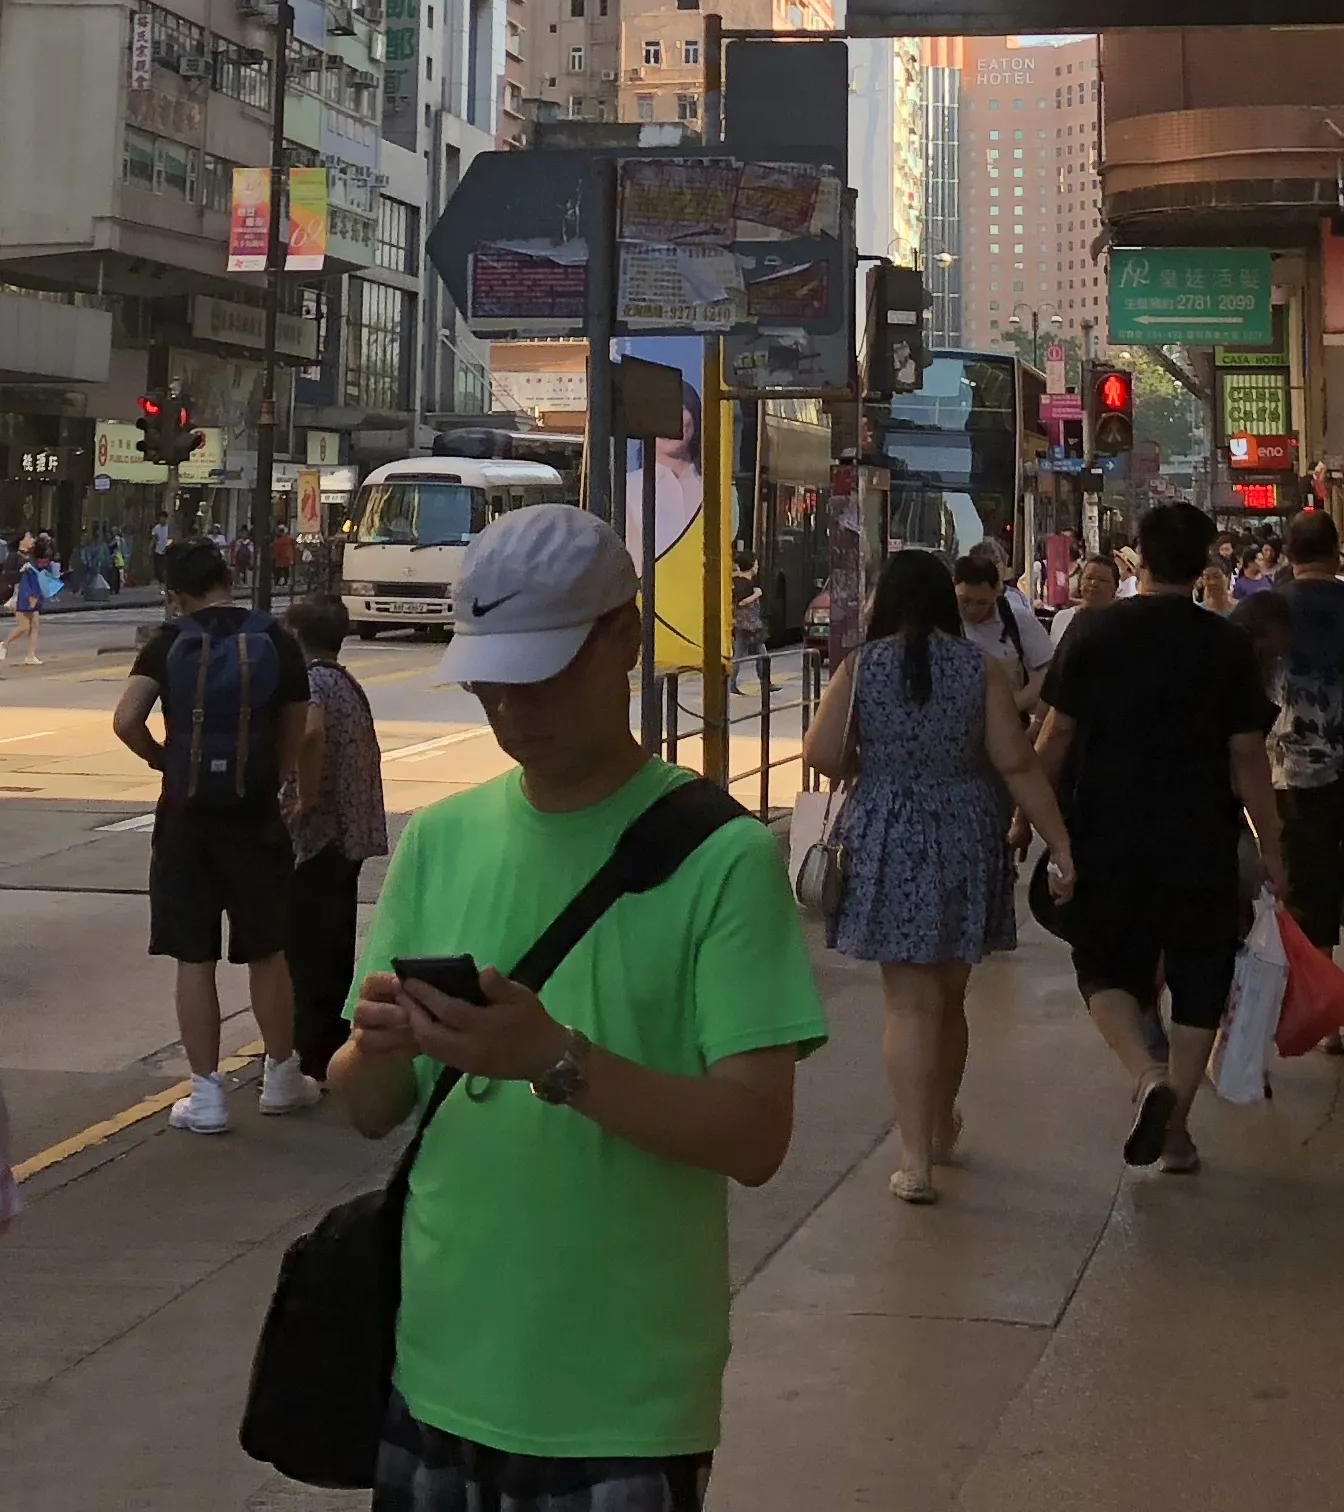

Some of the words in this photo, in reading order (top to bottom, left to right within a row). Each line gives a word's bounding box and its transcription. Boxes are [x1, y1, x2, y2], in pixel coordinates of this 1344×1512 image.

[977, 56, 1035, 70] EATON
[976, 72, 1034, 85] HOTEL
[1177, 294, 1212, 310] 2781
[1222, 355, 1250, 364] CASA
[1228, 388, 1281, 403] Casa
[1228, 403, 1281, 423] Café
[1257, 446, 1284, 457] eno
